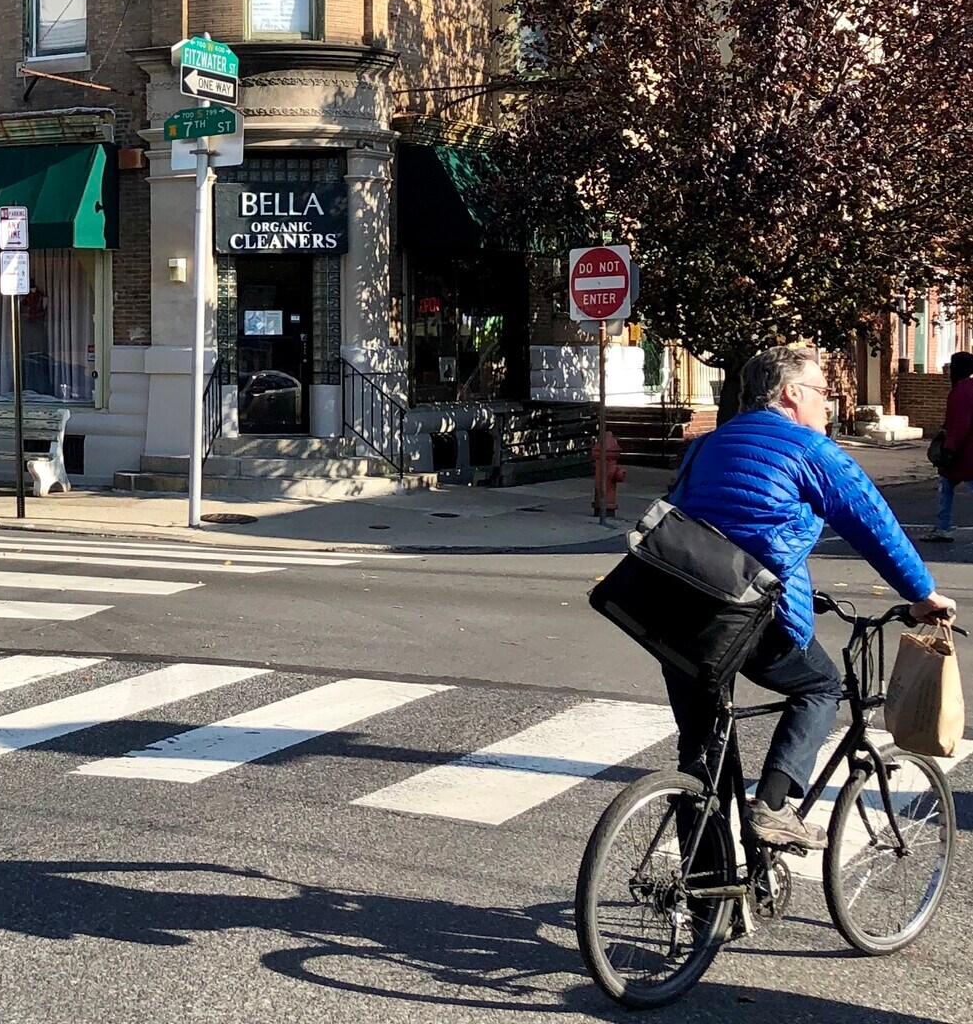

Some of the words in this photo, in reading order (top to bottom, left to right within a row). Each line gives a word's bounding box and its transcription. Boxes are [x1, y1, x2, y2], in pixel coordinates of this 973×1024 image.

[184, 47, 227, 72] FITZWATER
[229, 63, 236, 74] ST
[199, 78, 213, 90] ONE
[216, 82, 232, 95] WAY
[183, 120, 206, 137] 7TH
[218, 120, 232, 133] ST
[241, 192, 325, 216] BELLA
[251, 222, 312, 232] ORGANIC
[230, 233, 338, 250] CLEANERS
[579, 262, 593, 274] DO
[599, 261, 620, 273] NOT
[583, 293, 616, 306] ENTER
